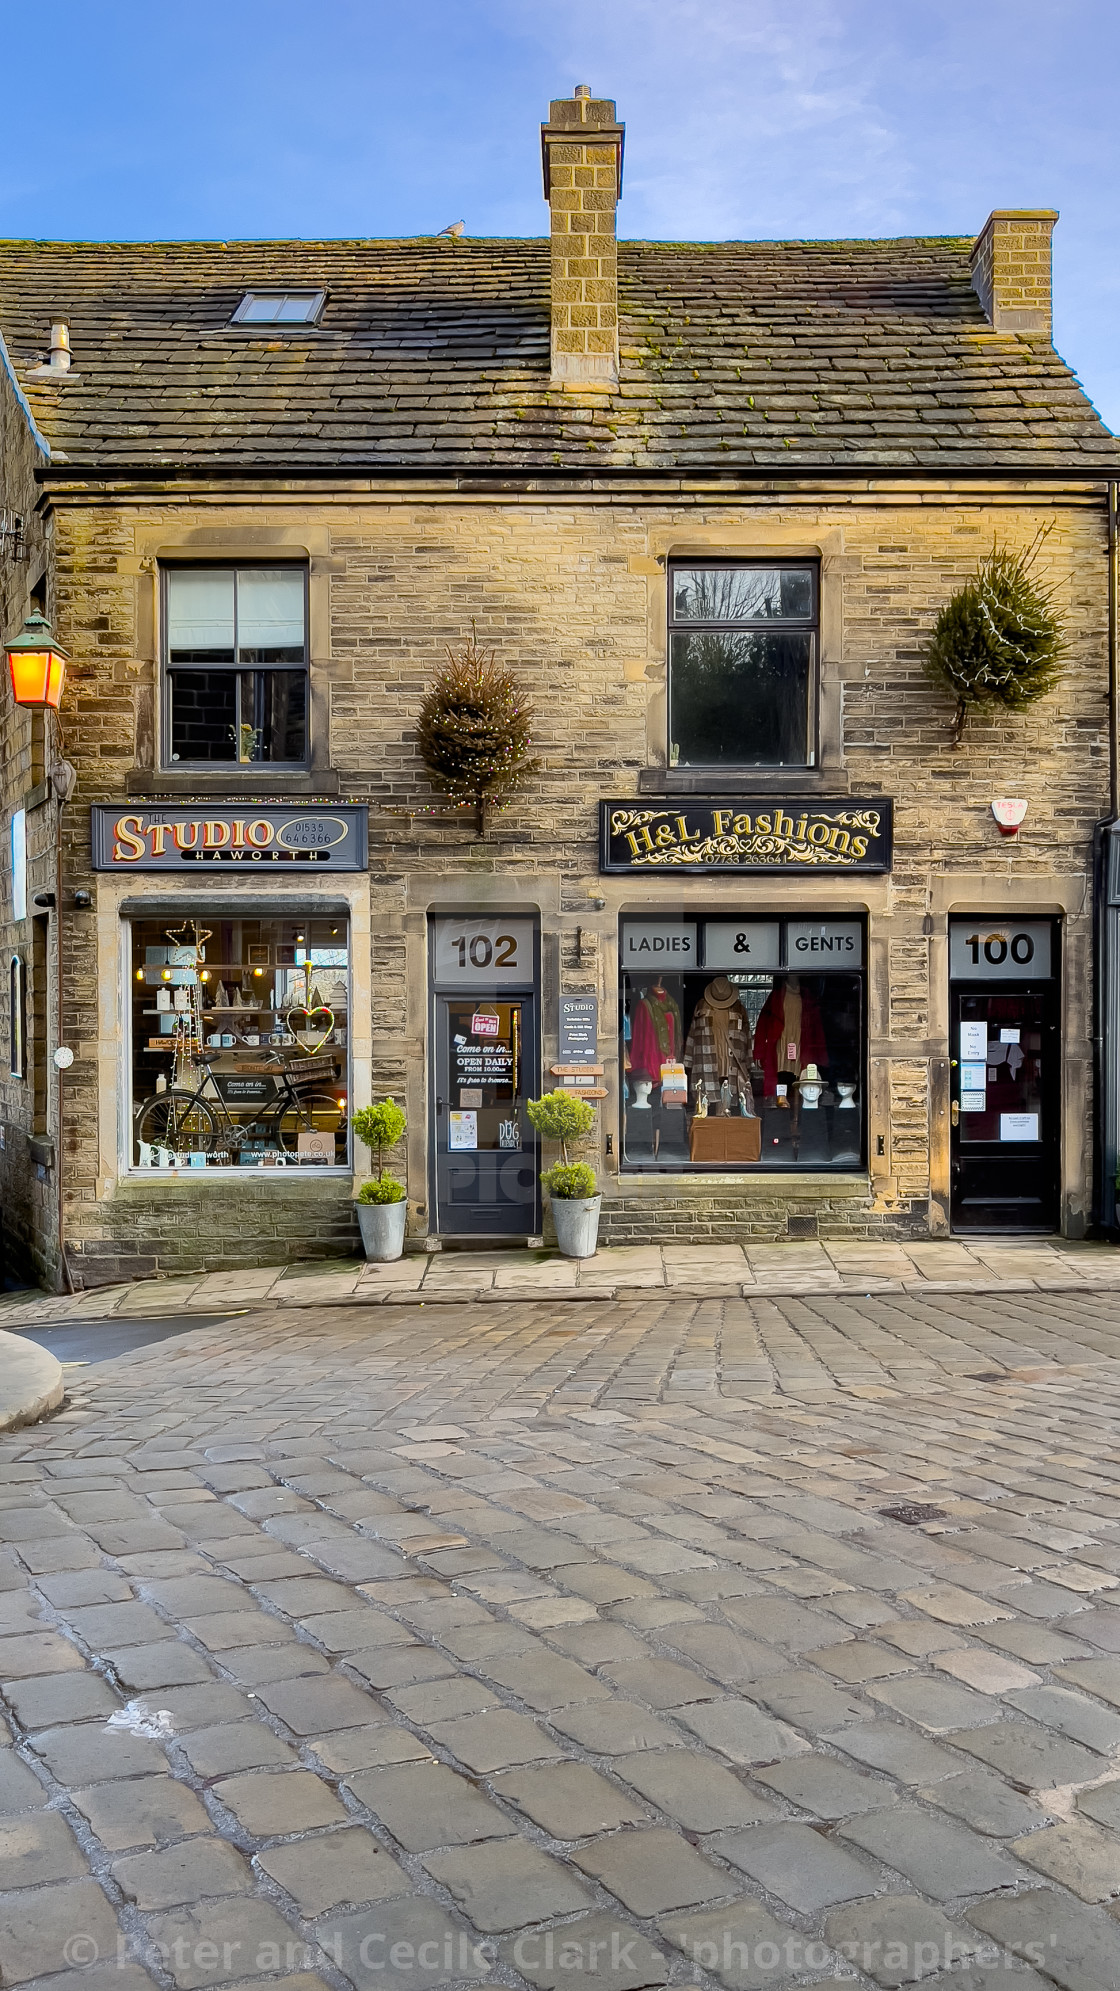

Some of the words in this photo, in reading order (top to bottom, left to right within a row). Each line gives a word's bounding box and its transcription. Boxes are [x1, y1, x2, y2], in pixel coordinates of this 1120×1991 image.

[996, 801, 1024, 809] TESLA
[149, 813, 167, 824] THE
[295, 823, 324, 833] 01535
[113, 815, 275, 862] STUDIO
[285, 833, 331, 844] 646366
[624, 815, 701, 858] H&L
[711, 809, 869, 859] Fashions
[195, 850, 318, 861] HAWORTH
[705, 853, 739, 864] 07733
[745, 853, 787, 864] 263641
[629, 936, 691, 952] LADIES
[733, 932, 751, 954] &
[795, 936, 855, 952] GENTS
[451, 935, 518, 968] 102
[965, 933, 1035, 965] 100
[563, 1003, 594, 1013] STUDIO
[474, 1022, 497, 1033] OPEN
[456, 1045, 481, 1054] Come
[456, 1058, 483, 1066] OPEN
[485, 1058, 514, 1066] DAILY
[498, 1119, 520, 1140] DOG
[250, 1150, 336, 1160] www.photopete.co.uk
